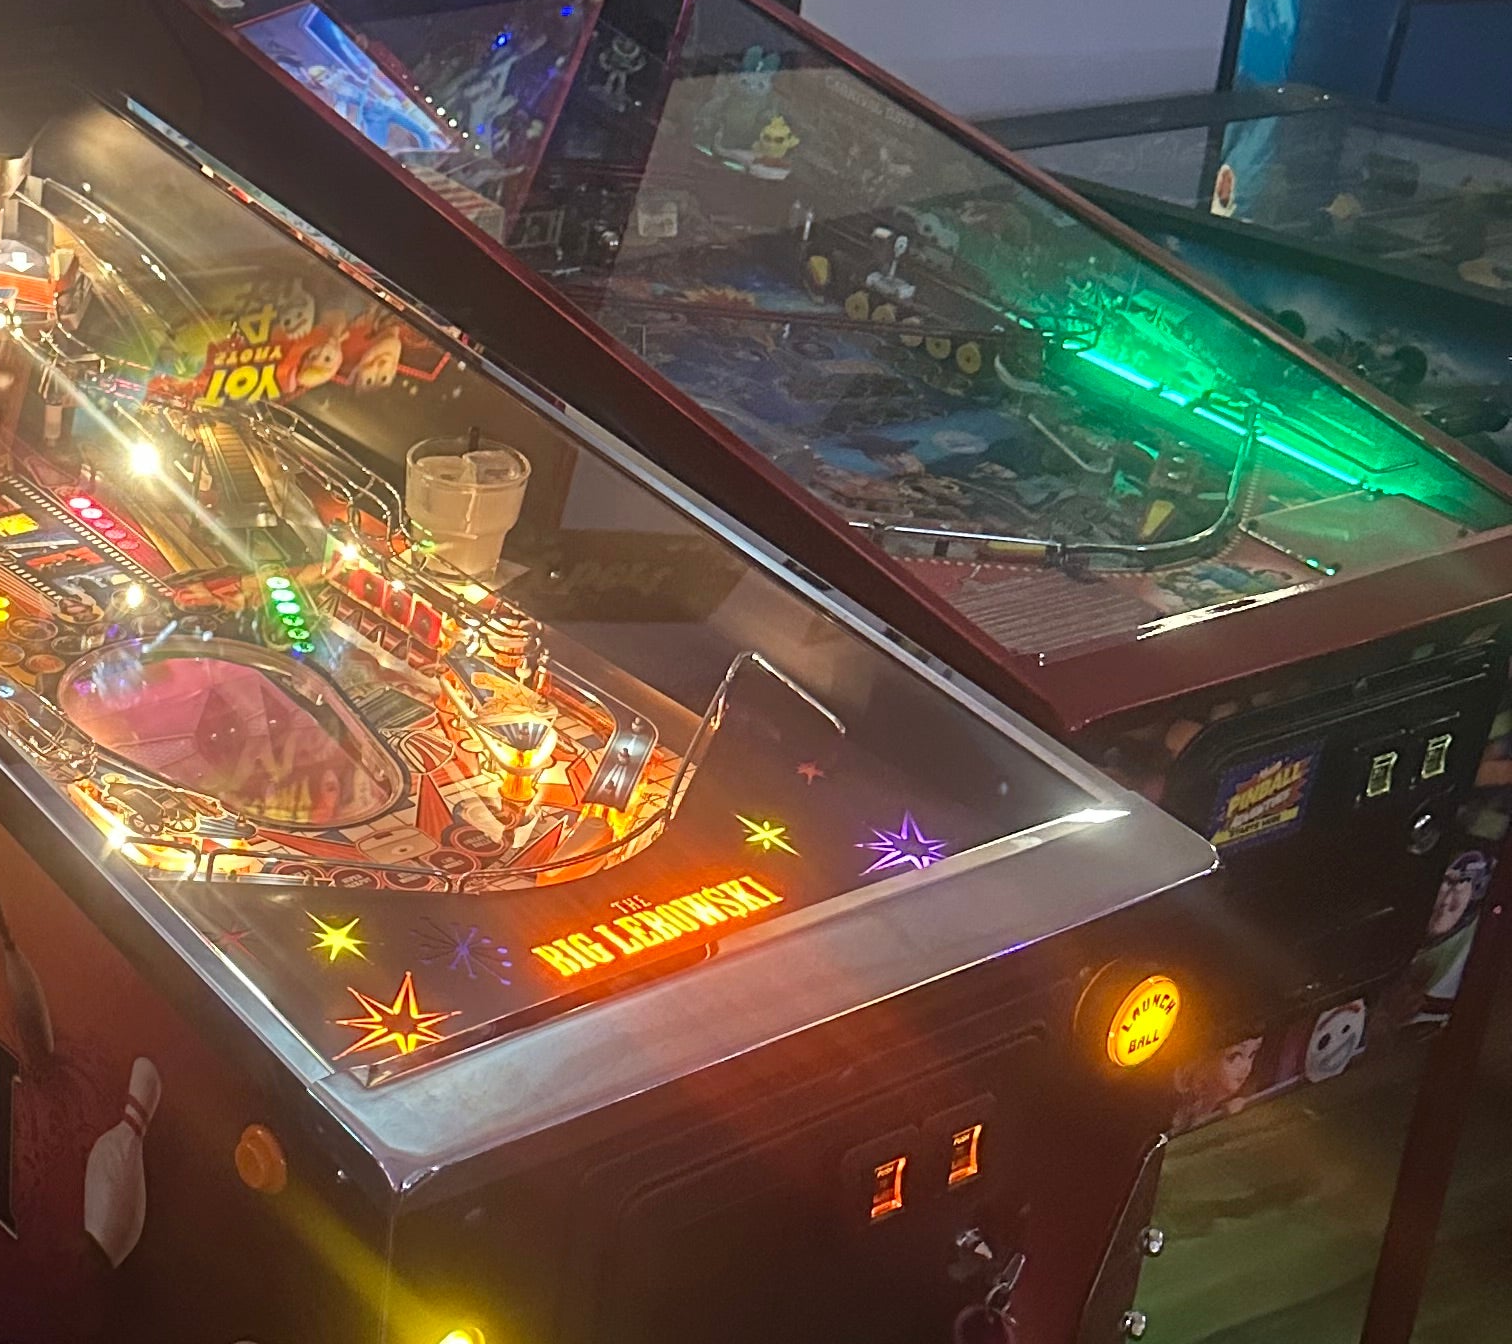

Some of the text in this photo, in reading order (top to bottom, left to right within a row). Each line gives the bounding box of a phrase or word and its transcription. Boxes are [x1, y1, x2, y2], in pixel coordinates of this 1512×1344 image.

[610, 893, 653, 916] THE
[531, 938, 598, 977] BIG
[1121, 992, 1176, 1033] LAUNCH
[1127, 1027, 1160, 1054] BALL
